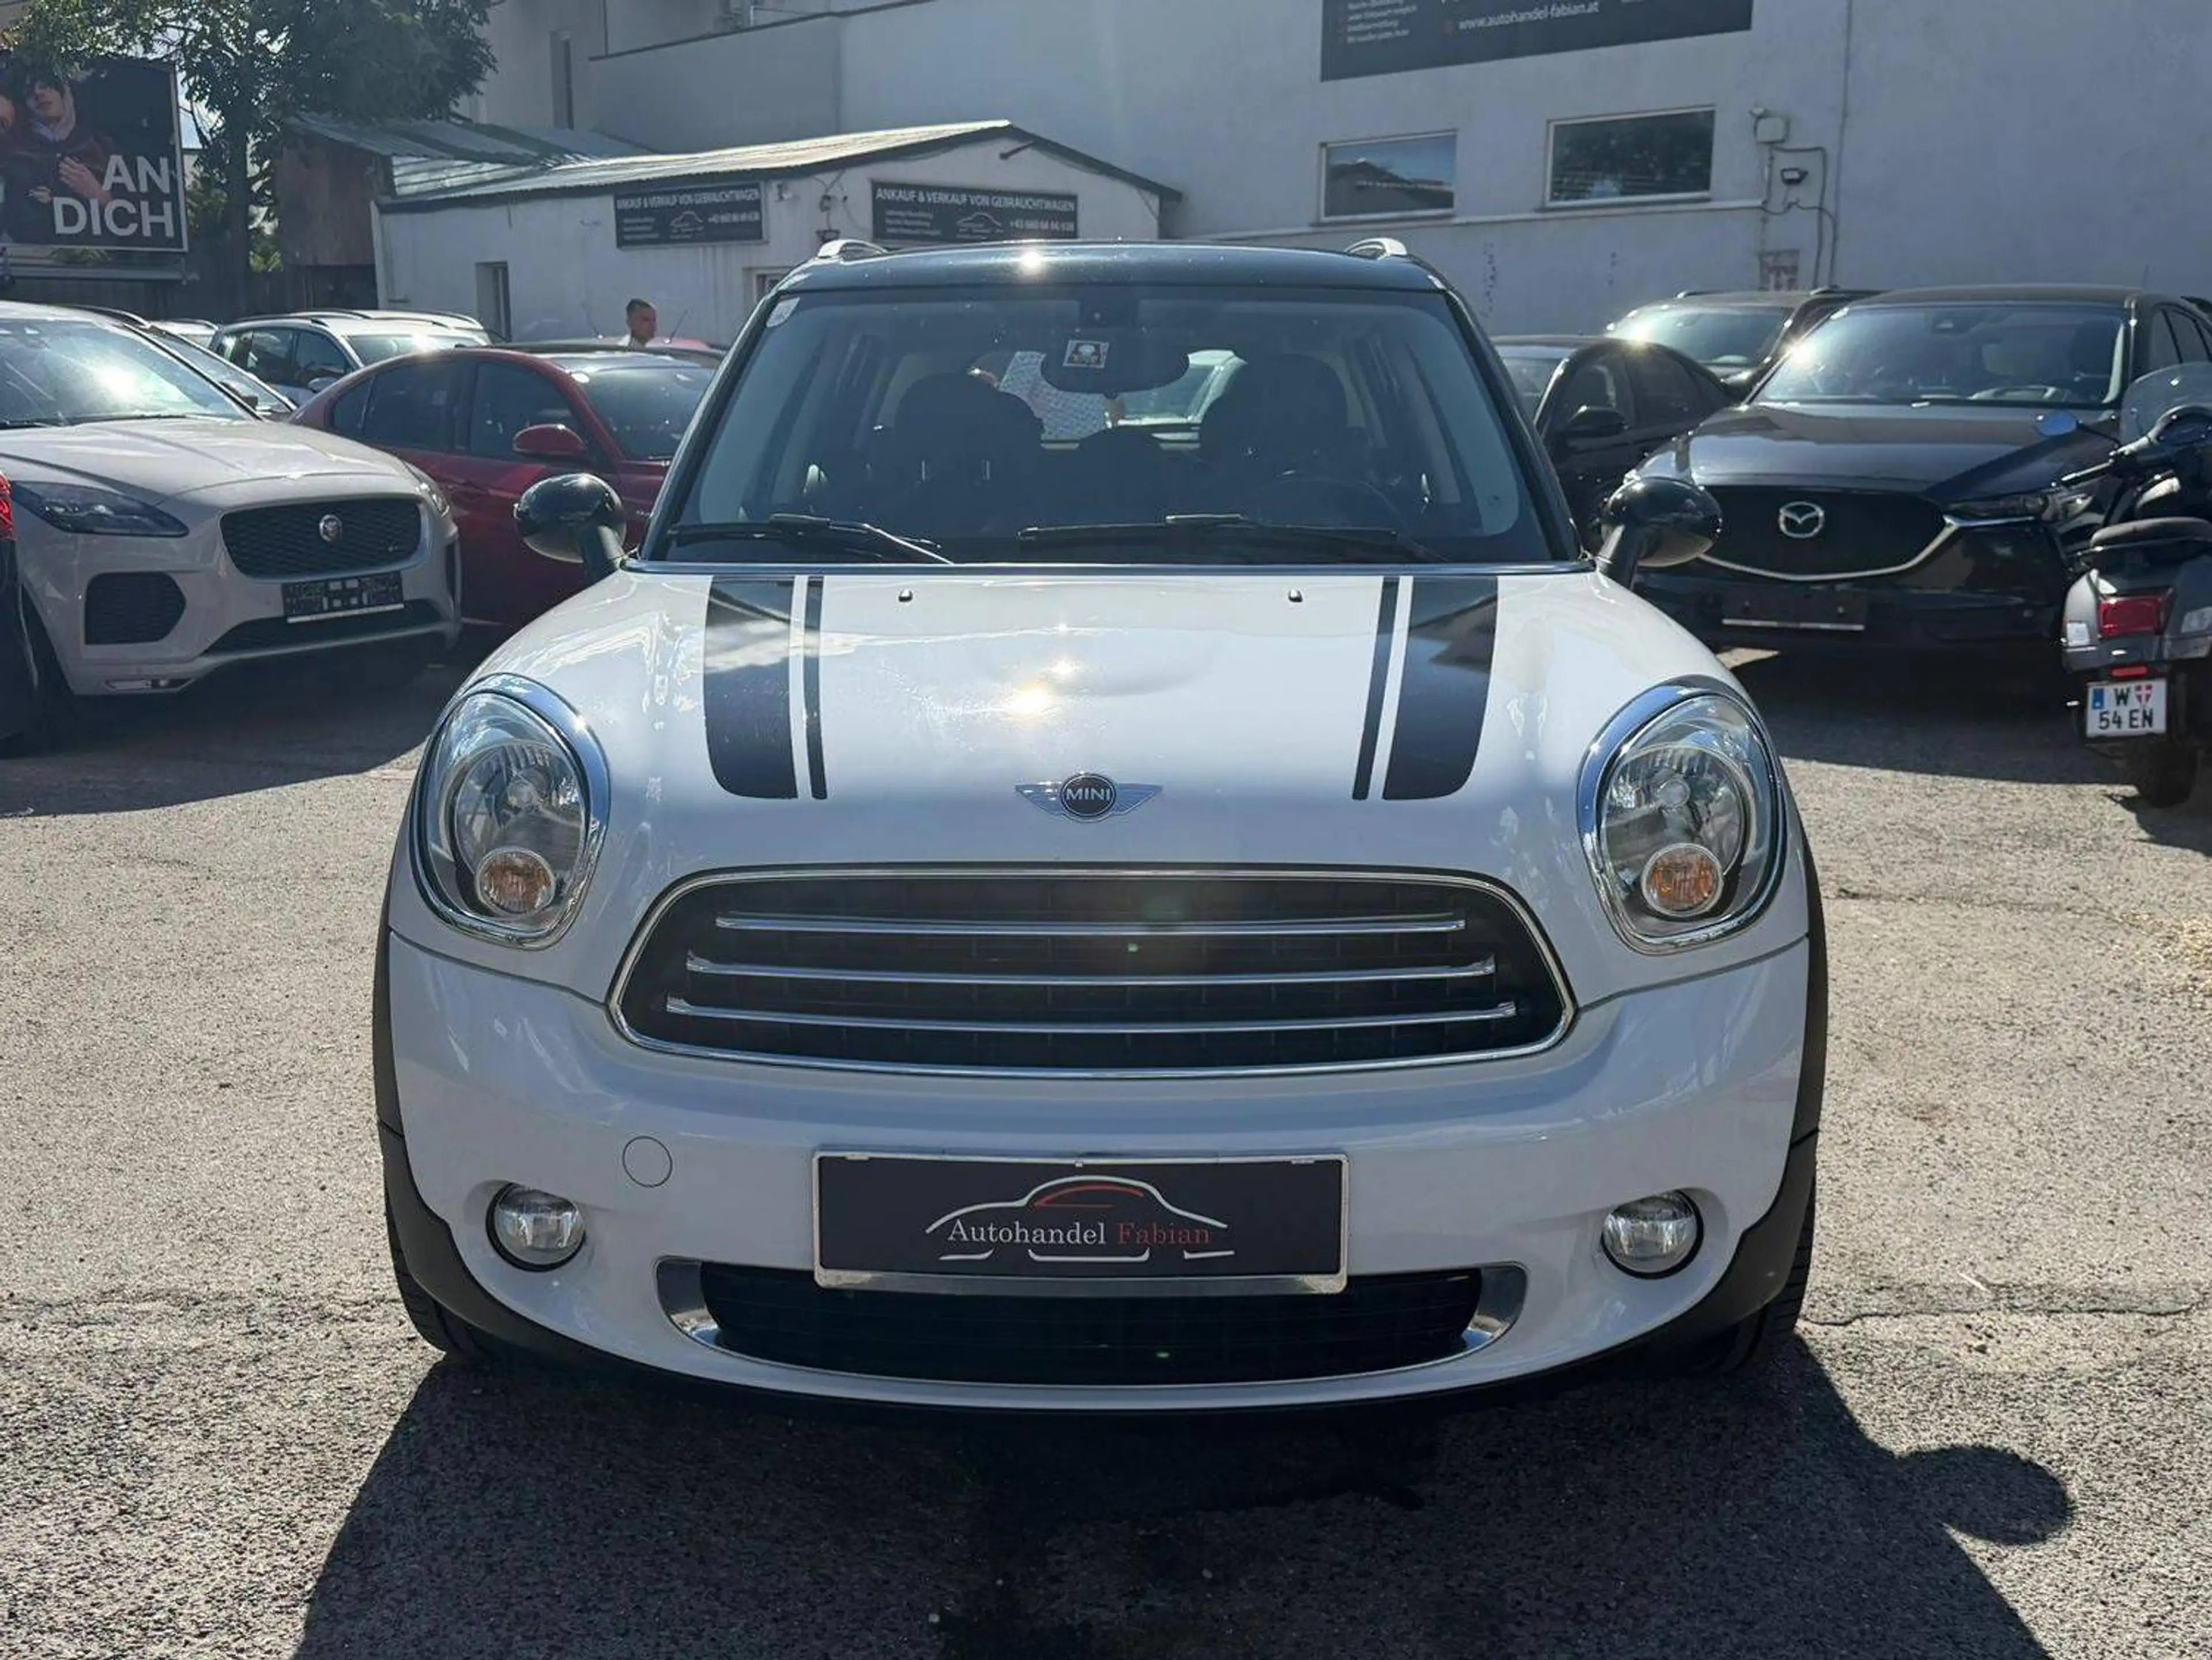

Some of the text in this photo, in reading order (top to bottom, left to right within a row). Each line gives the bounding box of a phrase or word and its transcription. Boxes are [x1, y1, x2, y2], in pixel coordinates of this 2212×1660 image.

[103, 154, 171, 194] AN
[53, 197, 175, 237] DICH
[2114, 687, 2130, 707] W
[2098, 708, 2153, 730] 54 EN
[1067, 788, 1110, 801] MINI
[947, 1219, 1211, 1246] Autohandel Fabian
